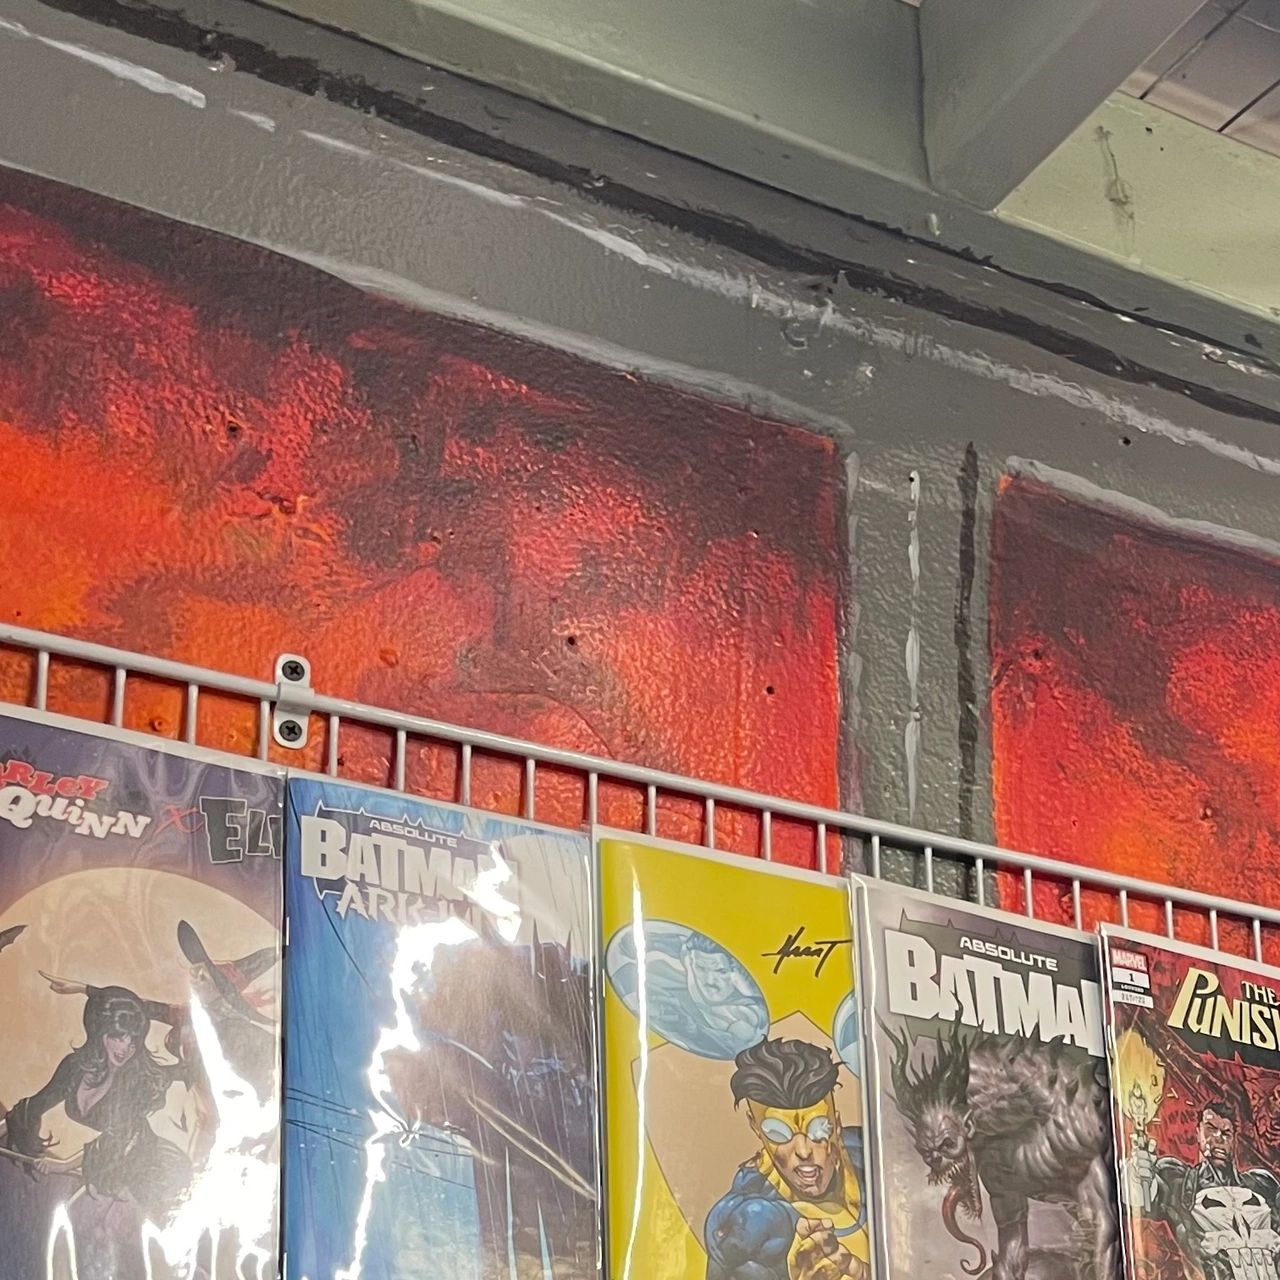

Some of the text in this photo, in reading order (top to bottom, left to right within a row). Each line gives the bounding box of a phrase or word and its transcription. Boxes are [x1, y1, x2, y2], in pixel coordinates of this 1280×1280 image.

[369, 819, 457, 848] ABSOLUTE
[960, 936, 1058, 971] ABSOLUTE
[1111, 949, 1148, 971] MARVEL
[1128, 972, 1135, 983] 1
[1241, 981, 1280, 1006] THE
